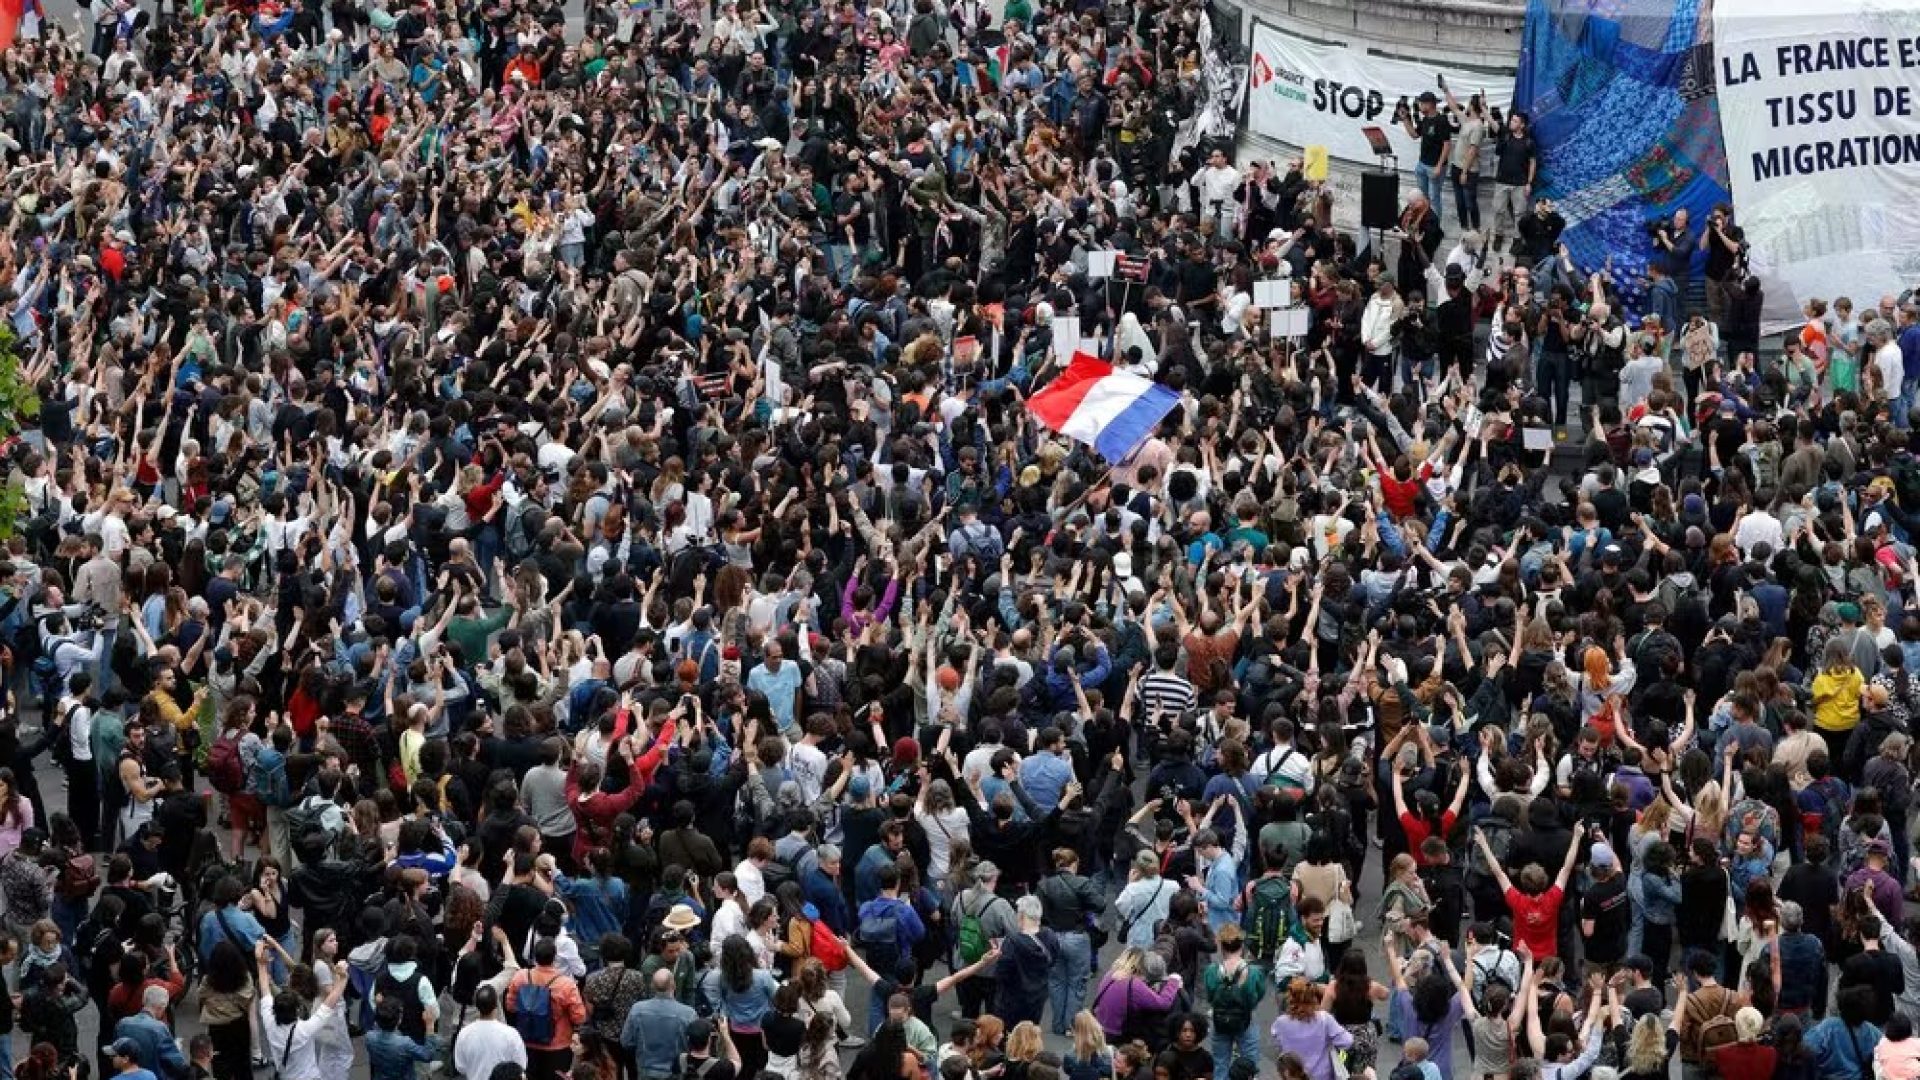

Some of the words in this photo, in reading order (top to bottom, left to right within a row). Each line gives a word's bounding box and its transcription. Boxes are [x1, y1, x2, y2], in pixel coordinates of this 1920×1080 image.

[1722, 52, 1761, 86] LA
[1776, 37, 1890, 77] FRANCE
[1313, 79, 1384, 121] STOP
[1766, 88, 1856, 127] TISSU
[1873, 86, 1911, 116] DE
[1752, 134, 1920, 182] MIGRATION
